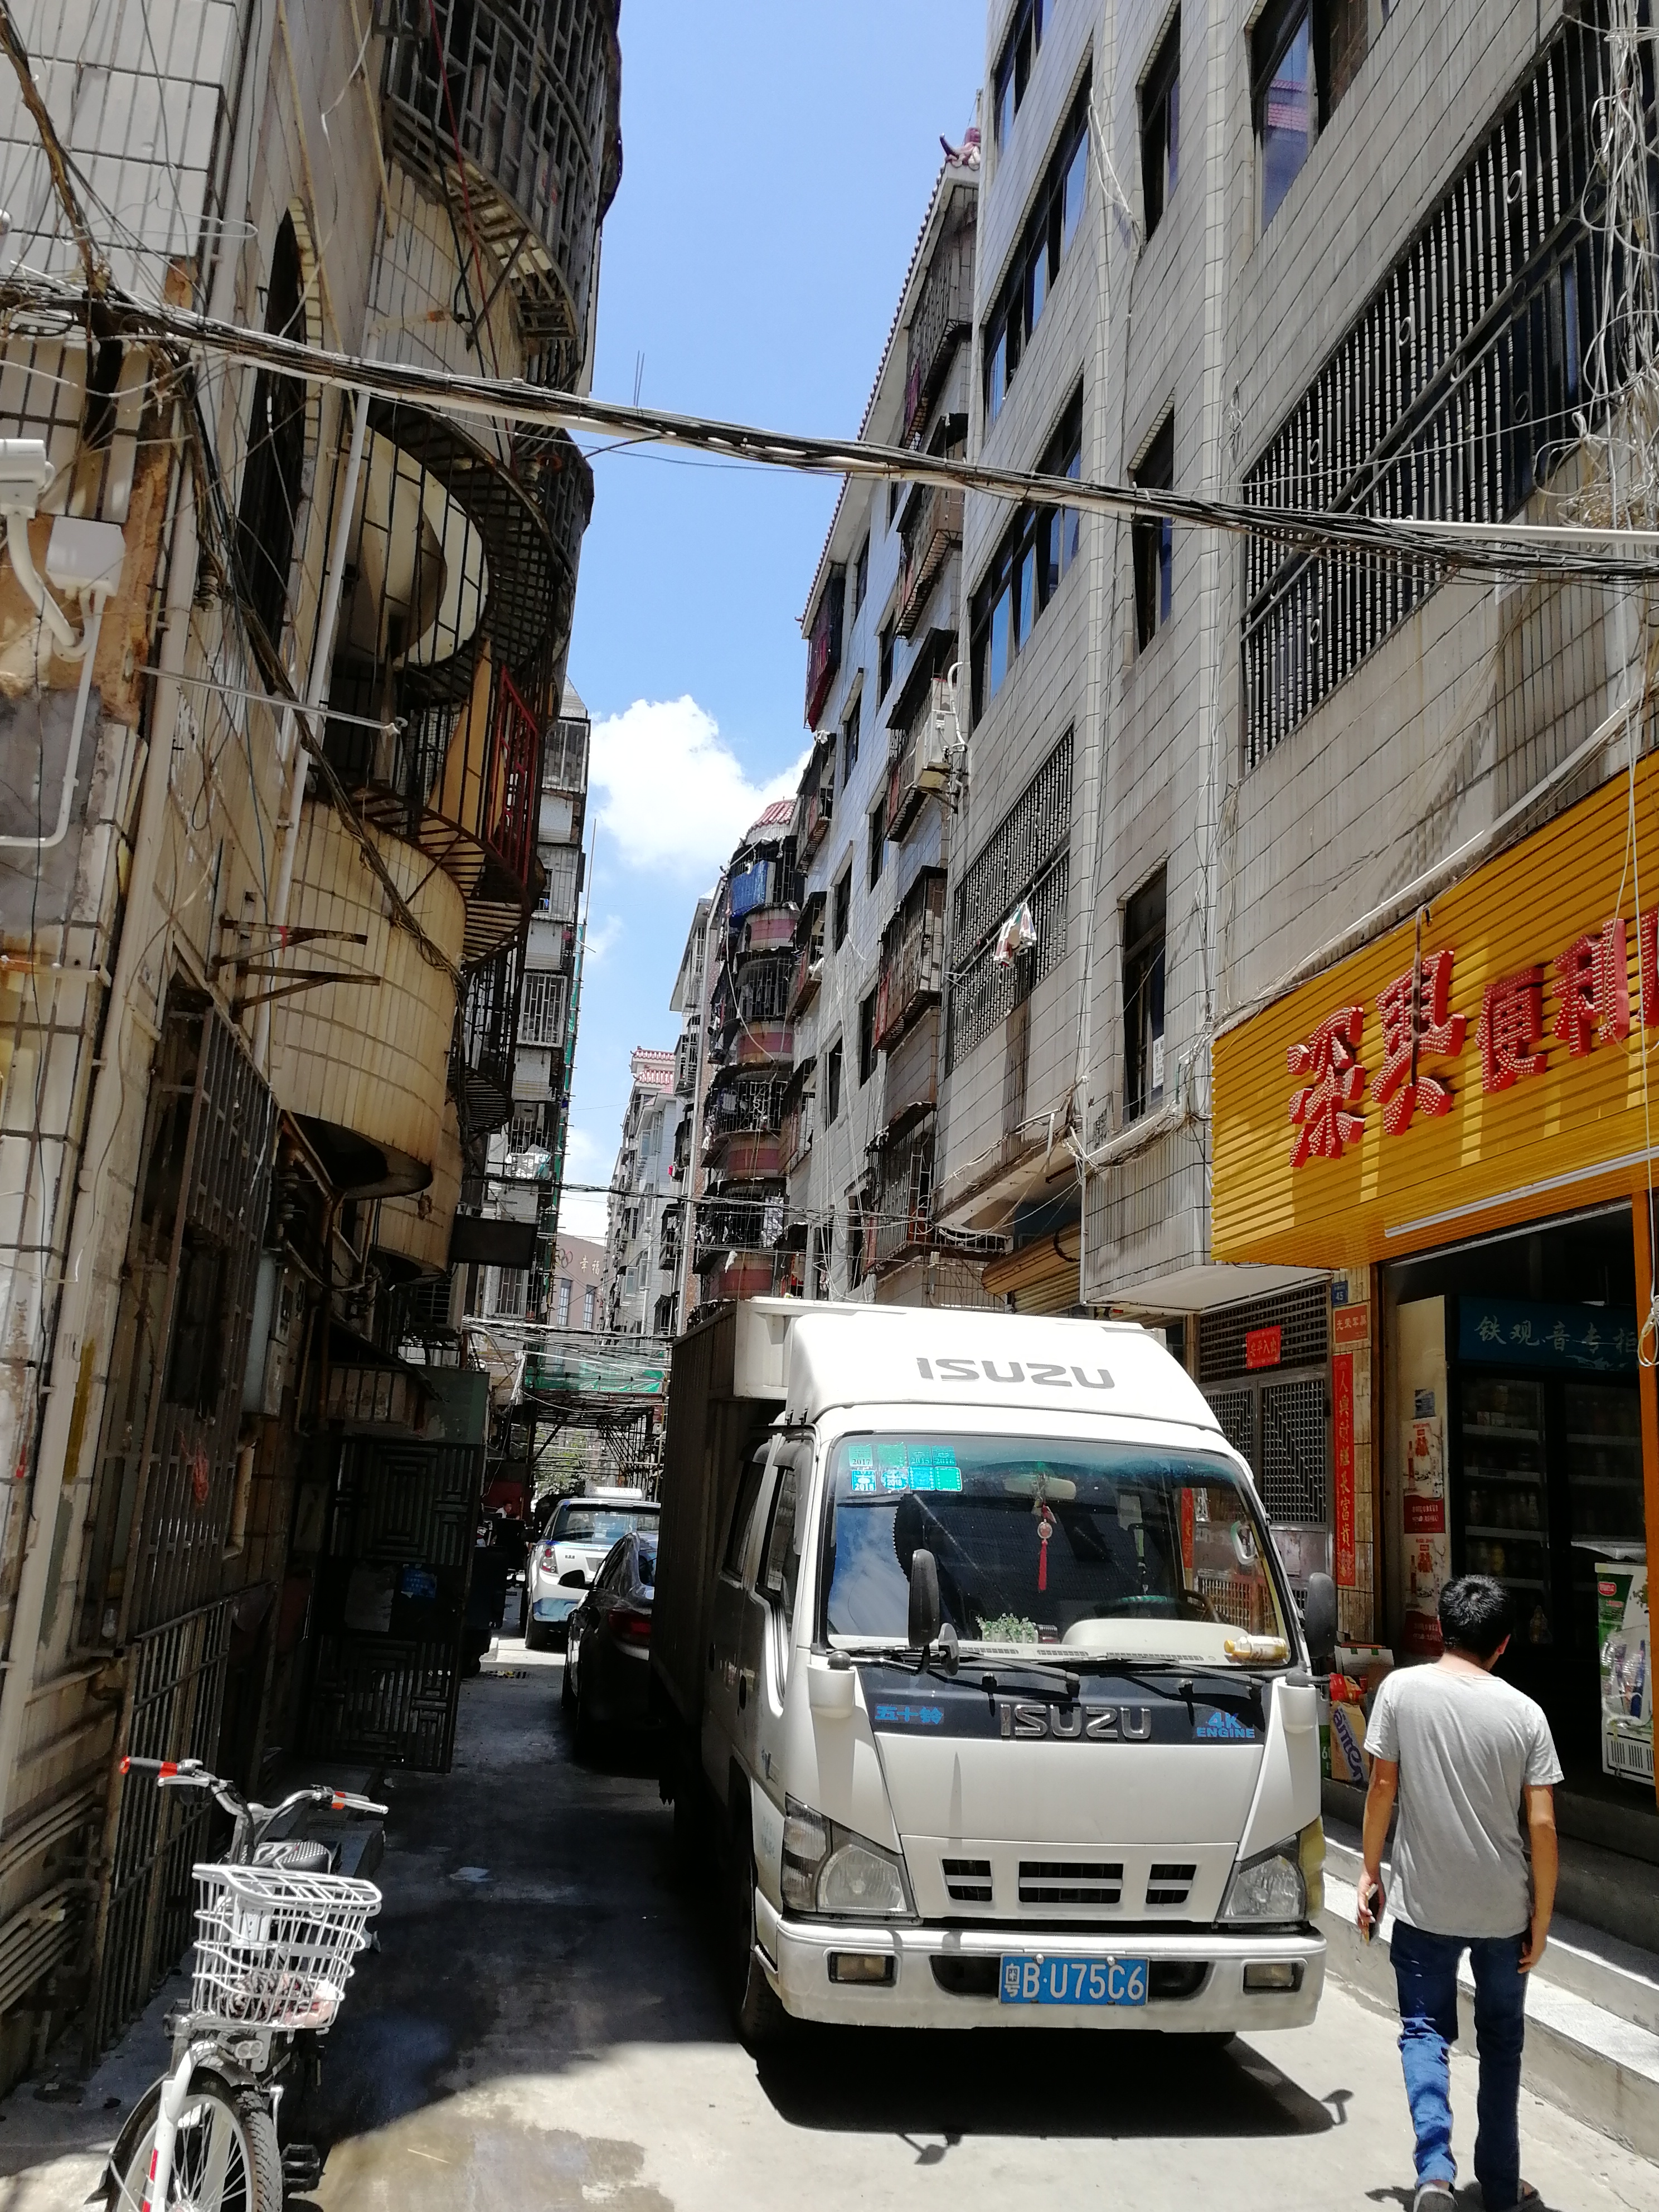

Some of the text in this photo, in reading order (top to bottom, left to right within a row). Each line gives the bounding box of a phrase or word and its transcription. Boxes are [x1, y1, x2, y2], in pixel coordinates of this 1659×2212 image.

[579, 1255, 600, 1275] 幸福
[1474, 1315, 1638, 1355] 铁观音专柜
[916, 1357, 1115, 1389] ISUZU
[1000, 1704, 1152, 1739] ISUZU
[1196, 1727, 1255, 1739] ENGINE
[1207, 1712, 1242, 1729] 4K
